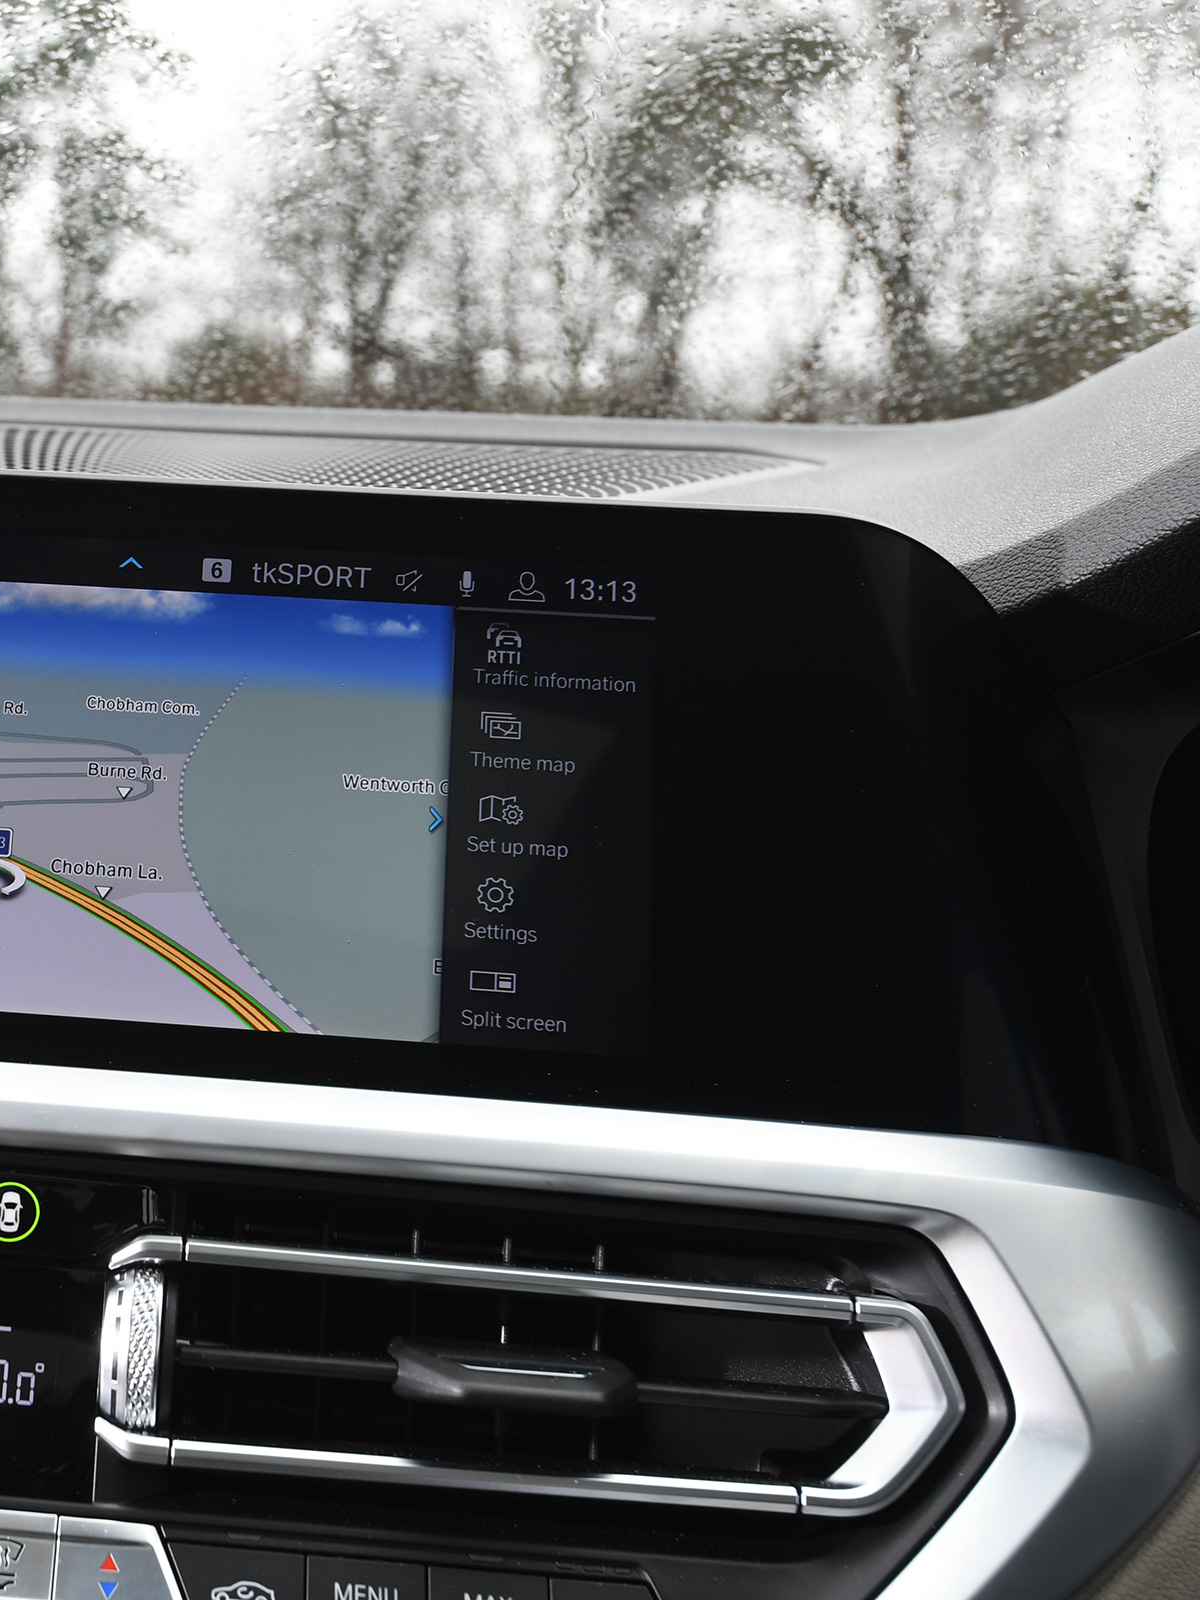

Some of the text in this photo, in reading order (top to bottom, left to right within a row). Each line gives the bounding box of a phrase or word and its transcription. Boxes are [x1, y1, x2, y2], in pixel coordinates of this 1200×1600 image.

[211, 562, 224, 579] 6
[252, 562, 372, 589] tkSPORT
[565, 578, 637, 603] 13:13
[487, 650, 521, 664] RTTI
[473, 668, 636, 692] Traffic information
[4, 701, 28, 715] Rd.
[86, 696, 200, 716] Chobham Com.
[87, 763, 167, 780] Burne Rd.
[470, 751, 576, 775] Theme map
[343, 774, 435, 795] Wentworth
[467, 836, 568, 860] Set up map
[51, 858, 163, 880] Chobham La.
[464, 922, 538, 945] Settings
[461, 1009, 567, 1032] Split screen
[334, 1581, 399, 1600] MENU
